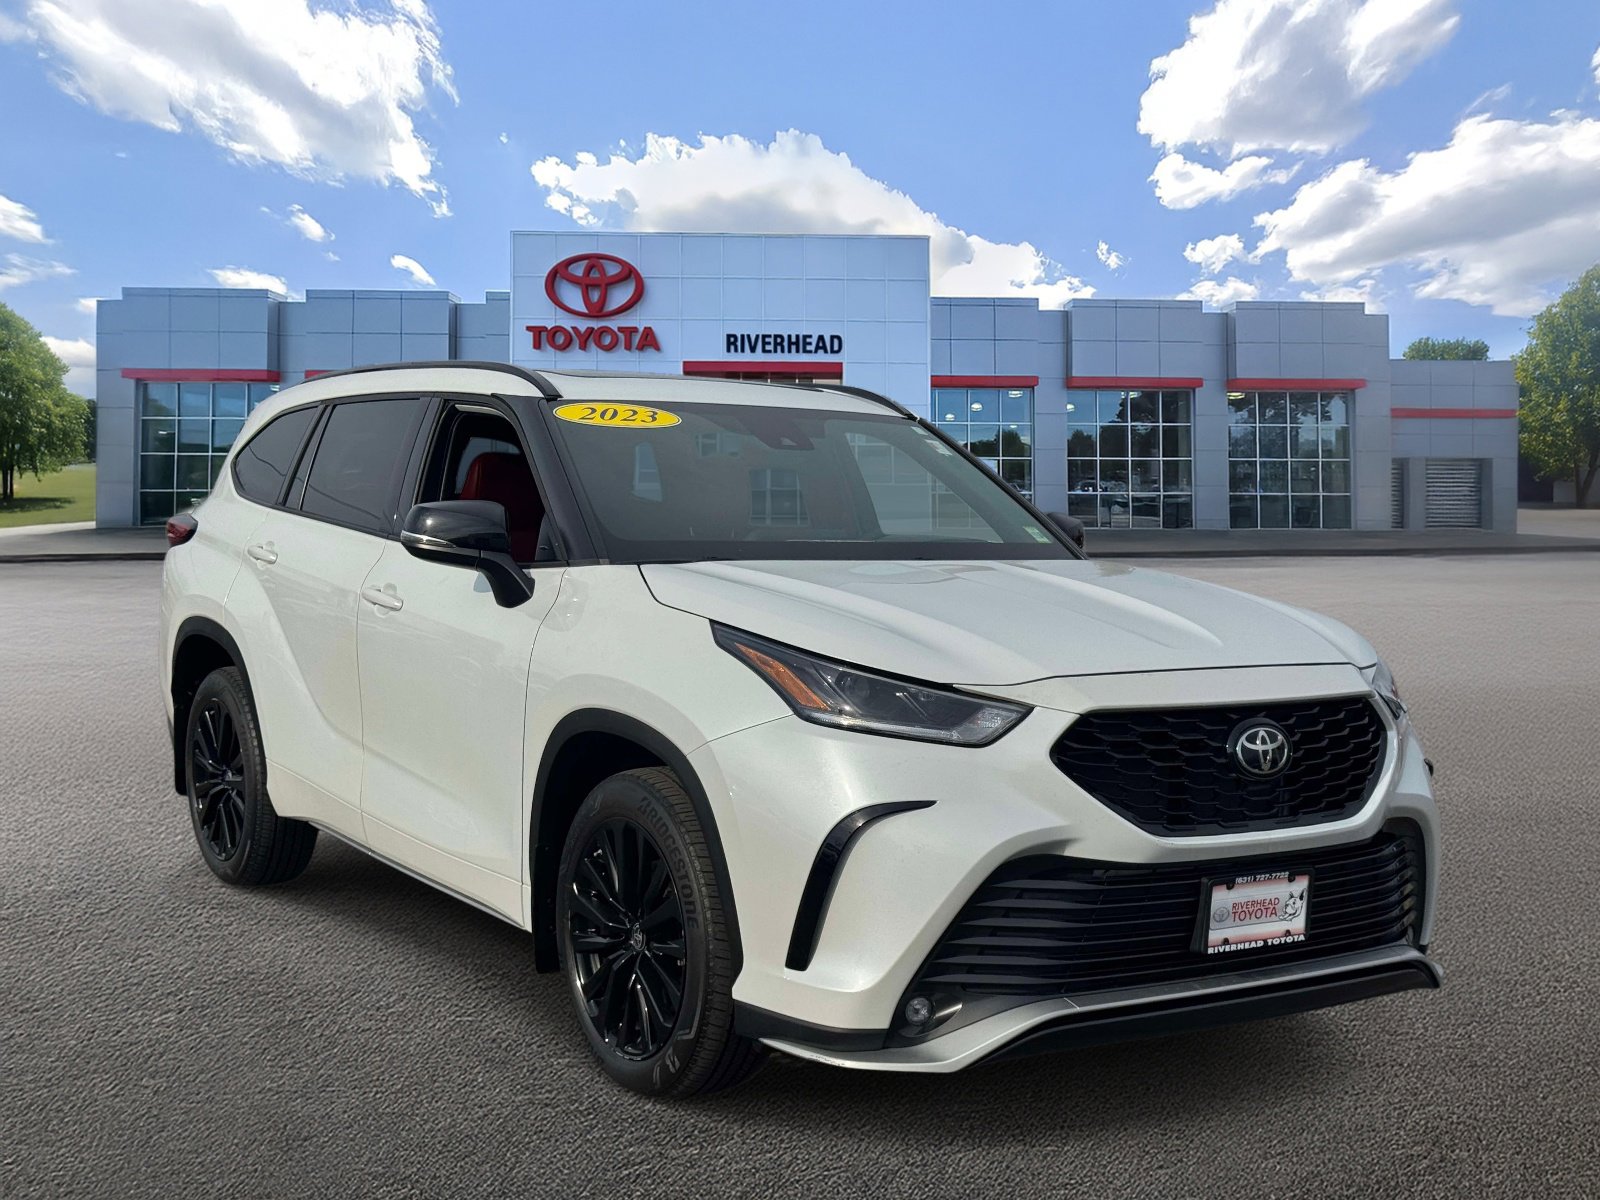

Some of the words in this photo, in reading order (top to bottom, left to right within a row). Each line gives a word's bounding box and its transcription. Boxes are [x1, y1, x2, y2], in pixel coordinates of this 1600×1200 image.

[526, 325, 660, 351] TOYOTA
[726, 333, 843, 354] RIVERHEAD
[578, 407, 658, 423] 2023
[637, 796, 699, 929] BRIDGESTONE
[1232, 897, 1280, 911] RIVERHEAD
[1232, 907, 1278, 922] TOYOTA
[1207, 940, 1264, 954] RIVERHEAD
[1267, 934, 1305, 946] TOYOTA
